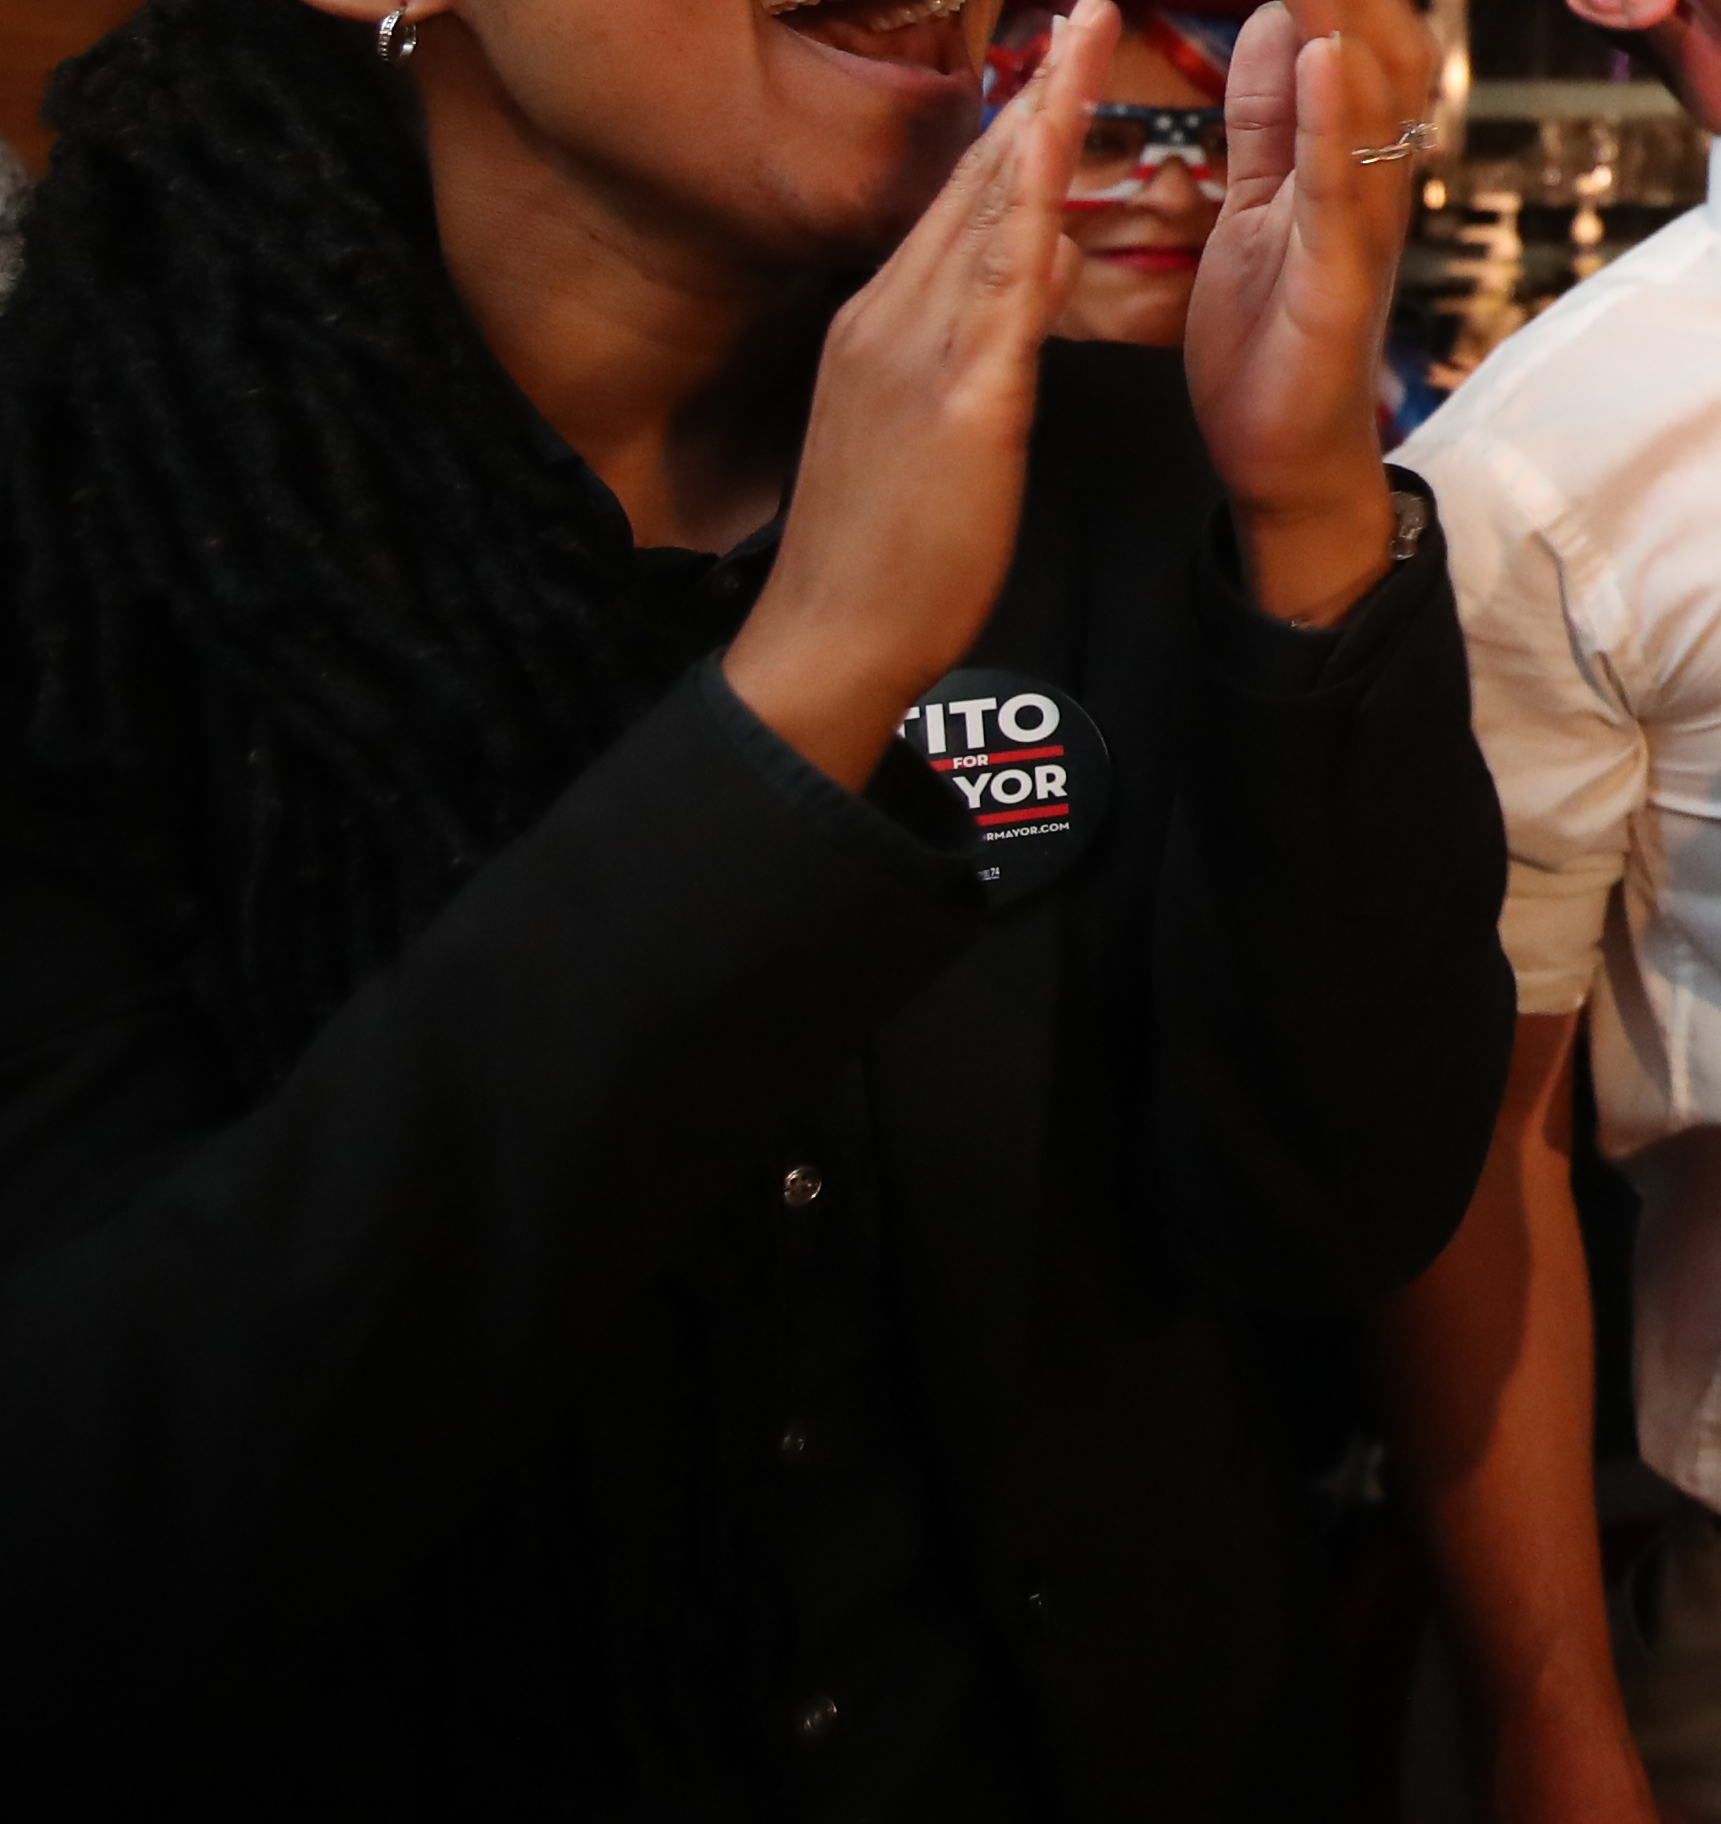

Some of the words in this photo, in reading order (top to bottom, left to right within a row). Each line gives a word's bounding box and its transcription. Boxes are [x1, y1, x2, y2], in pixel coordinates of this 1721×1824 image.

[953, 754, 989, 769] FOR
[953, 764, 1067, 809] YOR
[982, 822, 1070, 841] RMAYOR.COM
